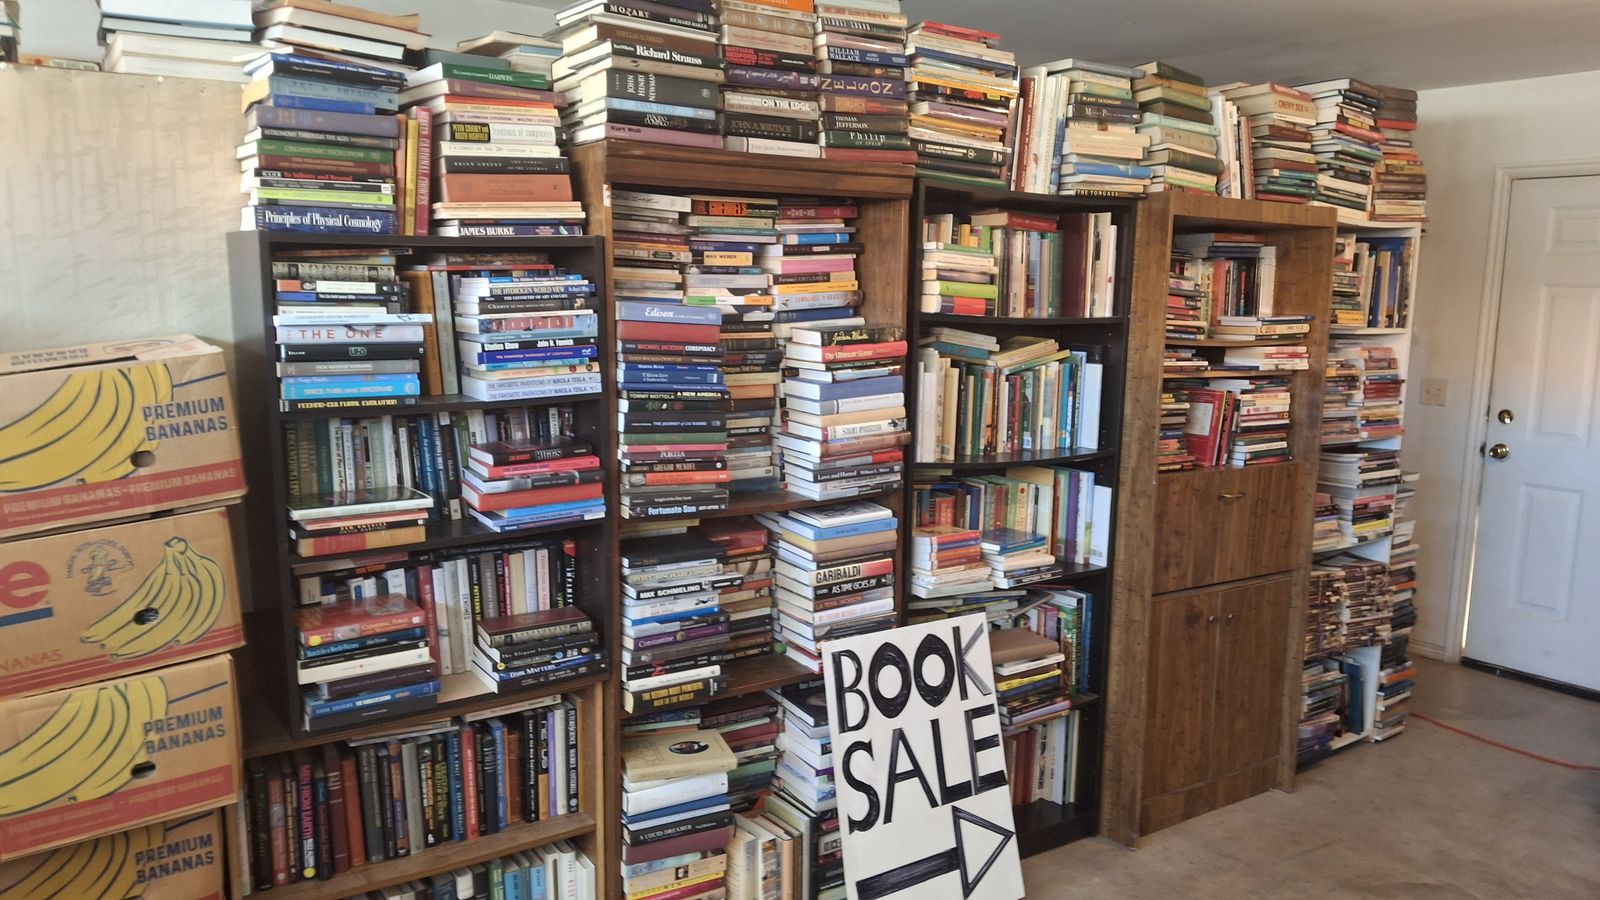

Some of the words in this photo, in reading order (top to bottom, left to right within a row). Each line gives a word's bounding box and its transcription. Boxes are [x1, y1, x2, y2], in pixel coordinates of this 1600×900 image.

[610, 4, 649, 18] MOZART
[636, 45, 670, 60] Richard
[672, 51, 702, 65] Strauss
[726, 52, 758, 60] BEDFORD
[830, 46, 859, 56] WILLIAM
[830, 53, 860, 62] WALLACE
[822, 78, 893, 95] NELSON
[762, 99, 774, 108] ON
[776, 101, 789, 109] THE
[790, 102, 810, 110] EDGE
[731, 120, 752, 128] JOHN
[850, 132, 886, 143] Philip
[419, 138, 430, 173] CARDINAL
[418, 176, 429, 205] CHOICES
[265, 210, 300, 228] Principles
[303, 212, 312, 224] of
[313, 212, 342, 229] Physical
[344, 214, 382, 232] Cosmology
[459, 227, 485, 236] JAMES
[486, 227, 515, 235] BURKE
[645, 307, 674, 318] Edison
[300, 330, 335, 339] THE
[346, 329, 383, 339] ONE
[142, 397, 224, 422] PREMIUM
[145, 416, 228, 441] BANANAS
[4, 496, 61, 513] PREMIUM
[63, 486, 120, 503] BANANAS
[128, 477, 183, 494] PREMIUM
[184, 468, 236, 484] BANANAS
[648, 506, 682, 515] Fortunate
[683, 505, 696, 513] Son
[816, 566, 860, 583] GARIBALDI
[657, 585, 700, 596] SCHMELING
[853, 581, 868, 590] GOES
[832, 622, 992, 733] BOOK
[144, 706, 222, 736] PREMIUM
[144, 724, 226, 754] BANANAS
[842, 704, 1009, 834] SALE
[302, 784, 313, 810] FROM
[304, 811, 314, 839] EARTH
[135, 834, 212, 865] PREMIUM
[136, 851, 215, 884] BANANAS
